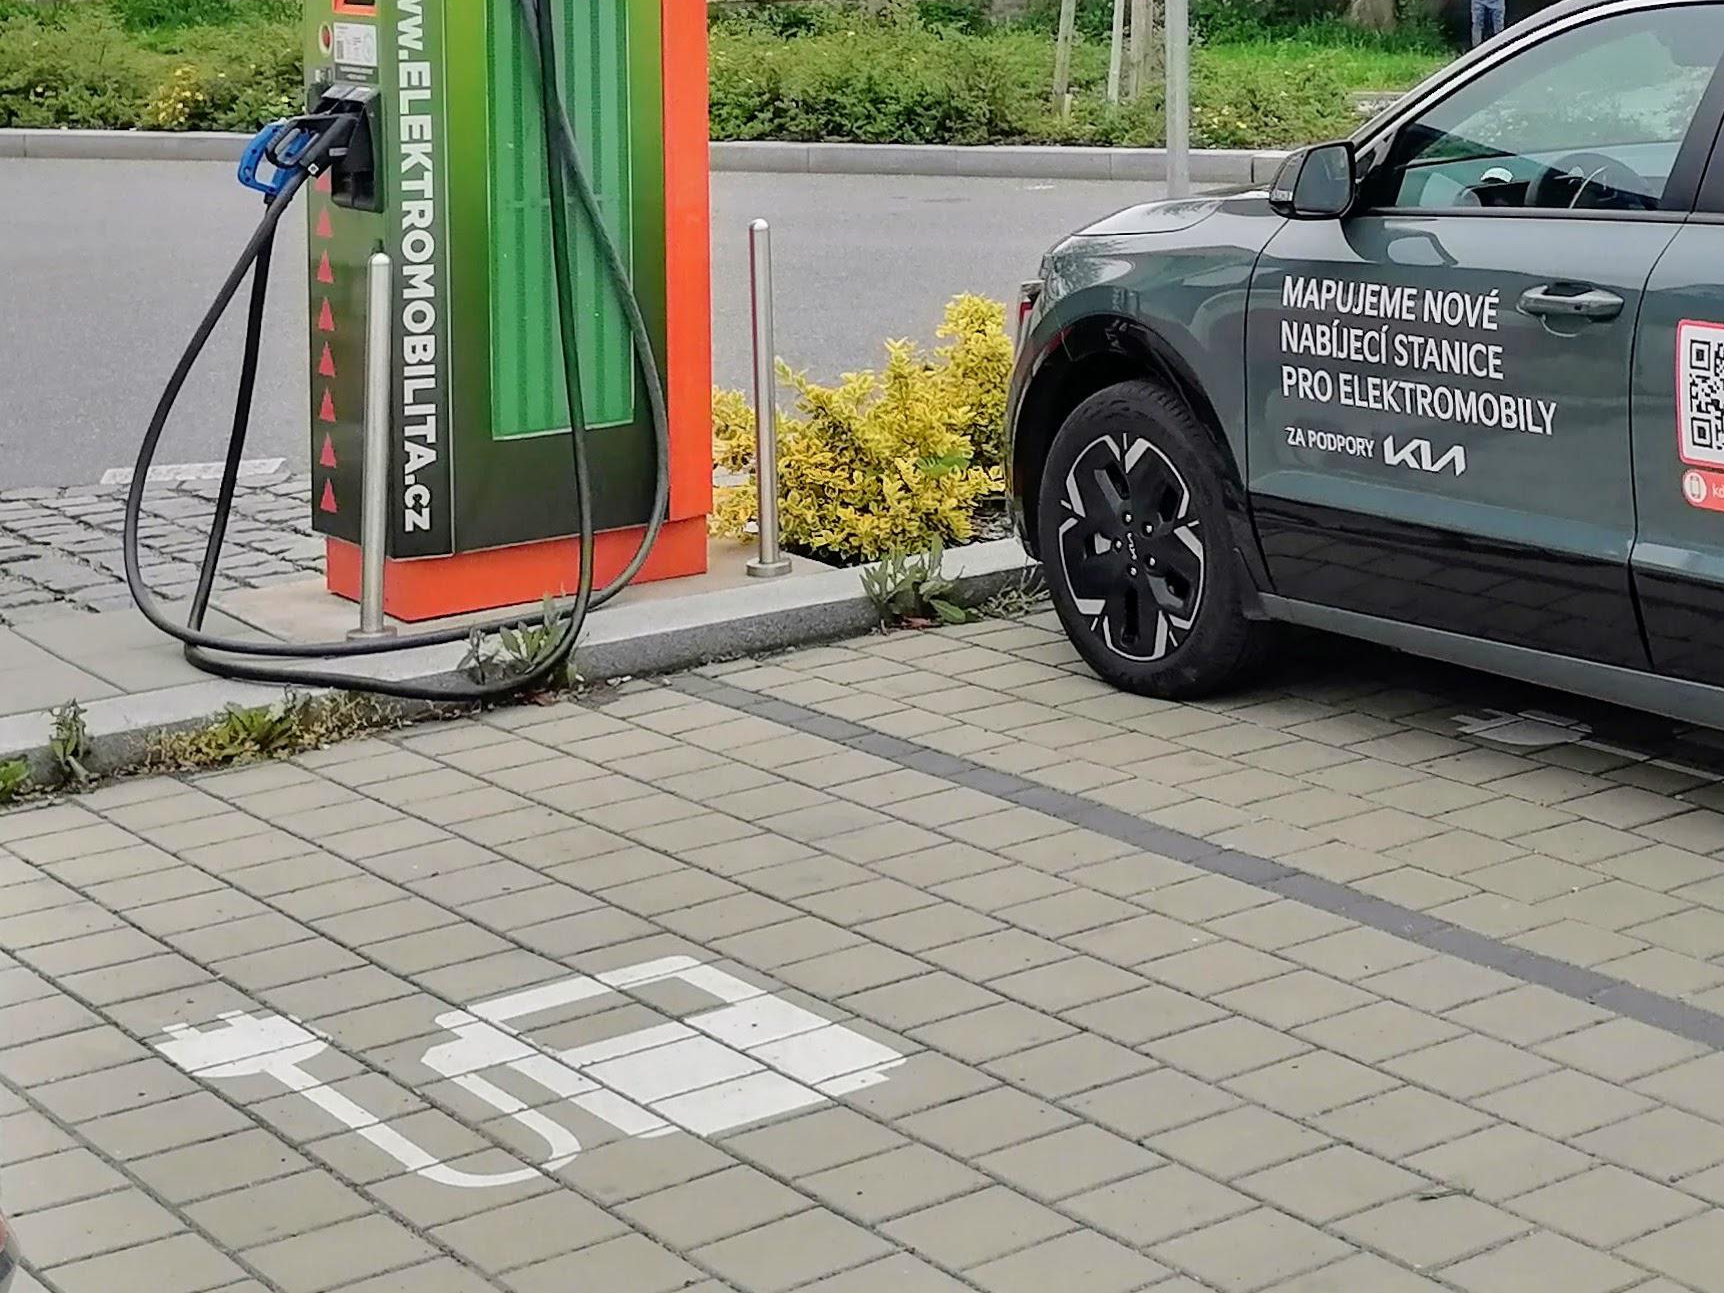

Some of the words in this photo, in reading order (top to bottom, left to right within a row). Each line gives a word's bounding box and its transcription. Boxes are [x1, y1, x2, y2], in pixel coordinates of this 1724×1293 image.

[1282, 275, 1417, 321] MAPUJEME
[1423, 288, 1500, 330] NOVÉ
[1281, 319, 1388, 364] NABÍJECÍ
[1394, 333, 1504, 380] STANICE
[1282, 365, 1333, 403] PRO
[1339, 372, 1557, 436] ELEKTROMOBILY
[1285, 426, 1306, 448] ZA
[1308, 430, 1375, 458] PODPORY
[1383, 436, 1467, 477] KIA
